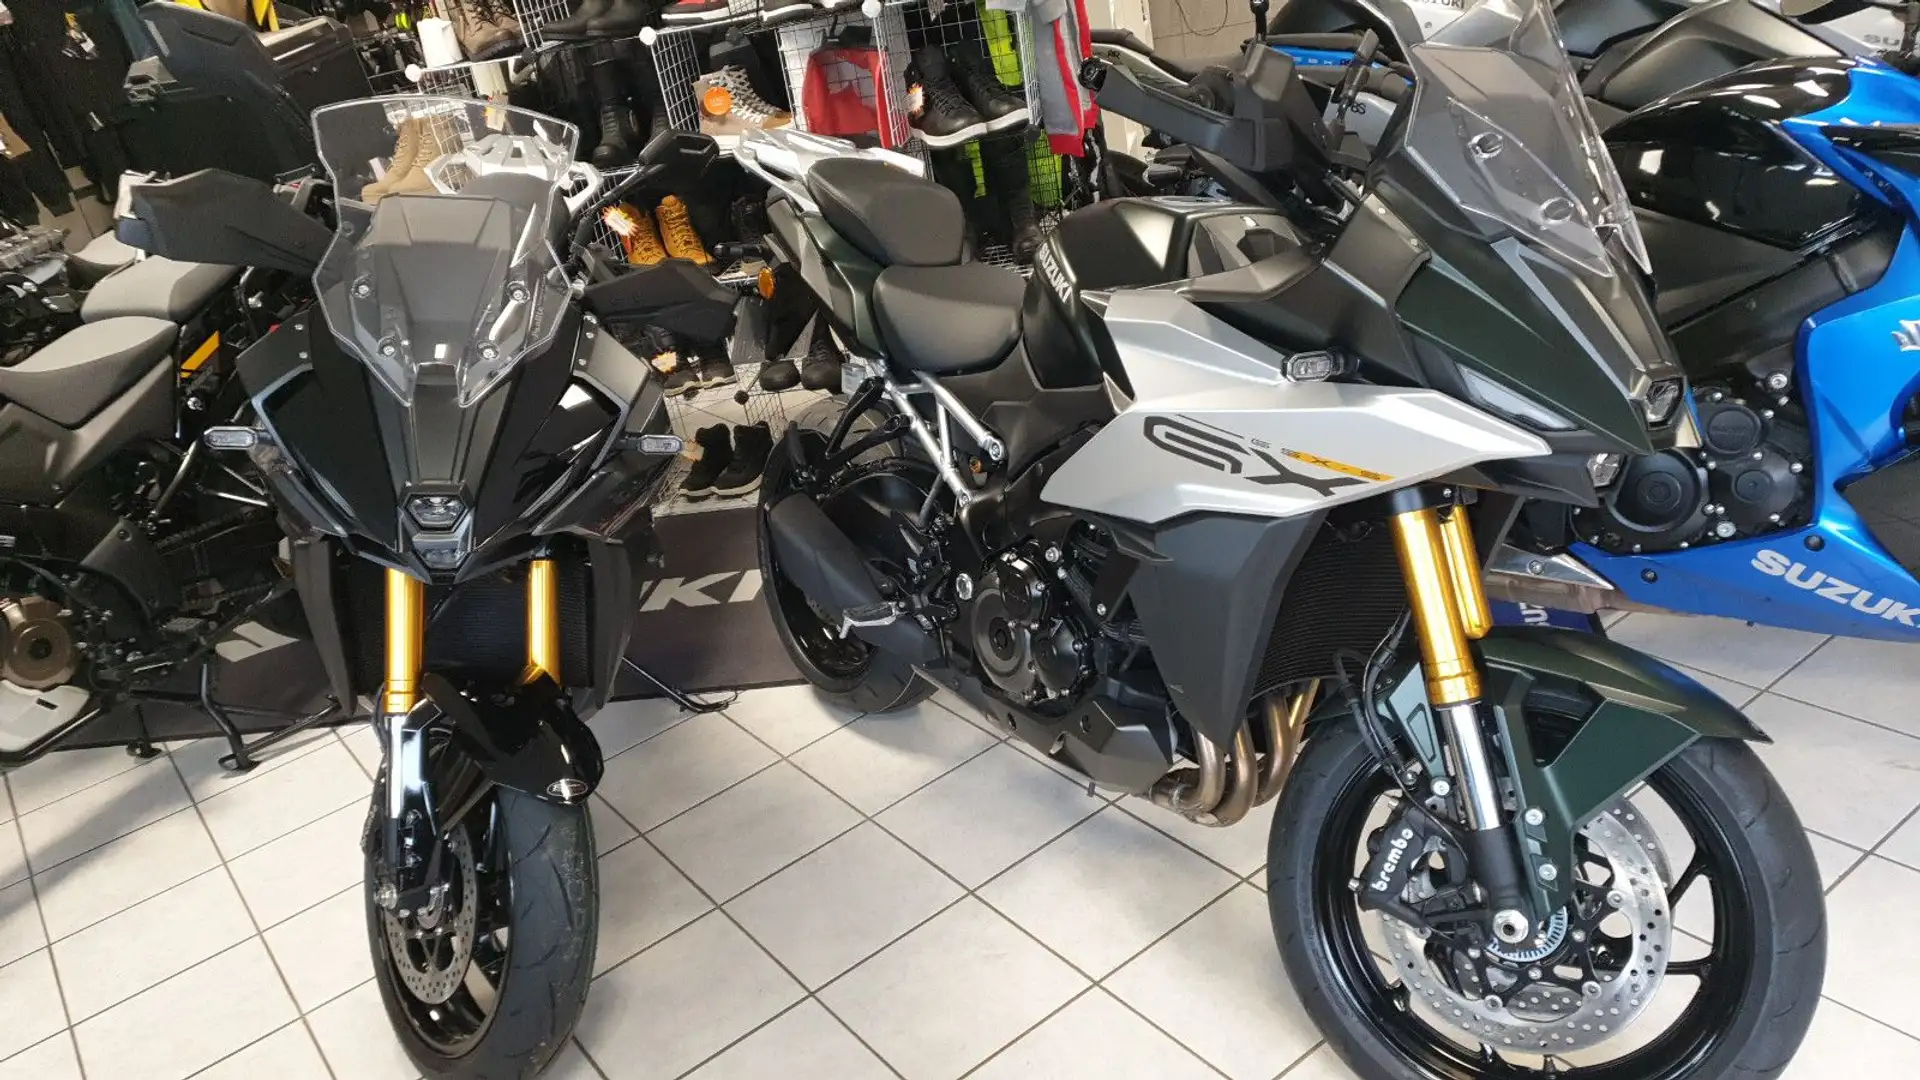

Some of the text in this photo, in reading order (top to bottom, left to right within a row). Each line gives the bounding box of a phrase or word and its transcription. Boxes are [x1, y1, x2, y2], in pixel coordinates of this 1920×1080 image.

[1040, 242, 1072, 304] SUZUKI
[1751, 549, 1920, 629] SUZUK
[1371, 828, 1414, 892] brembo
